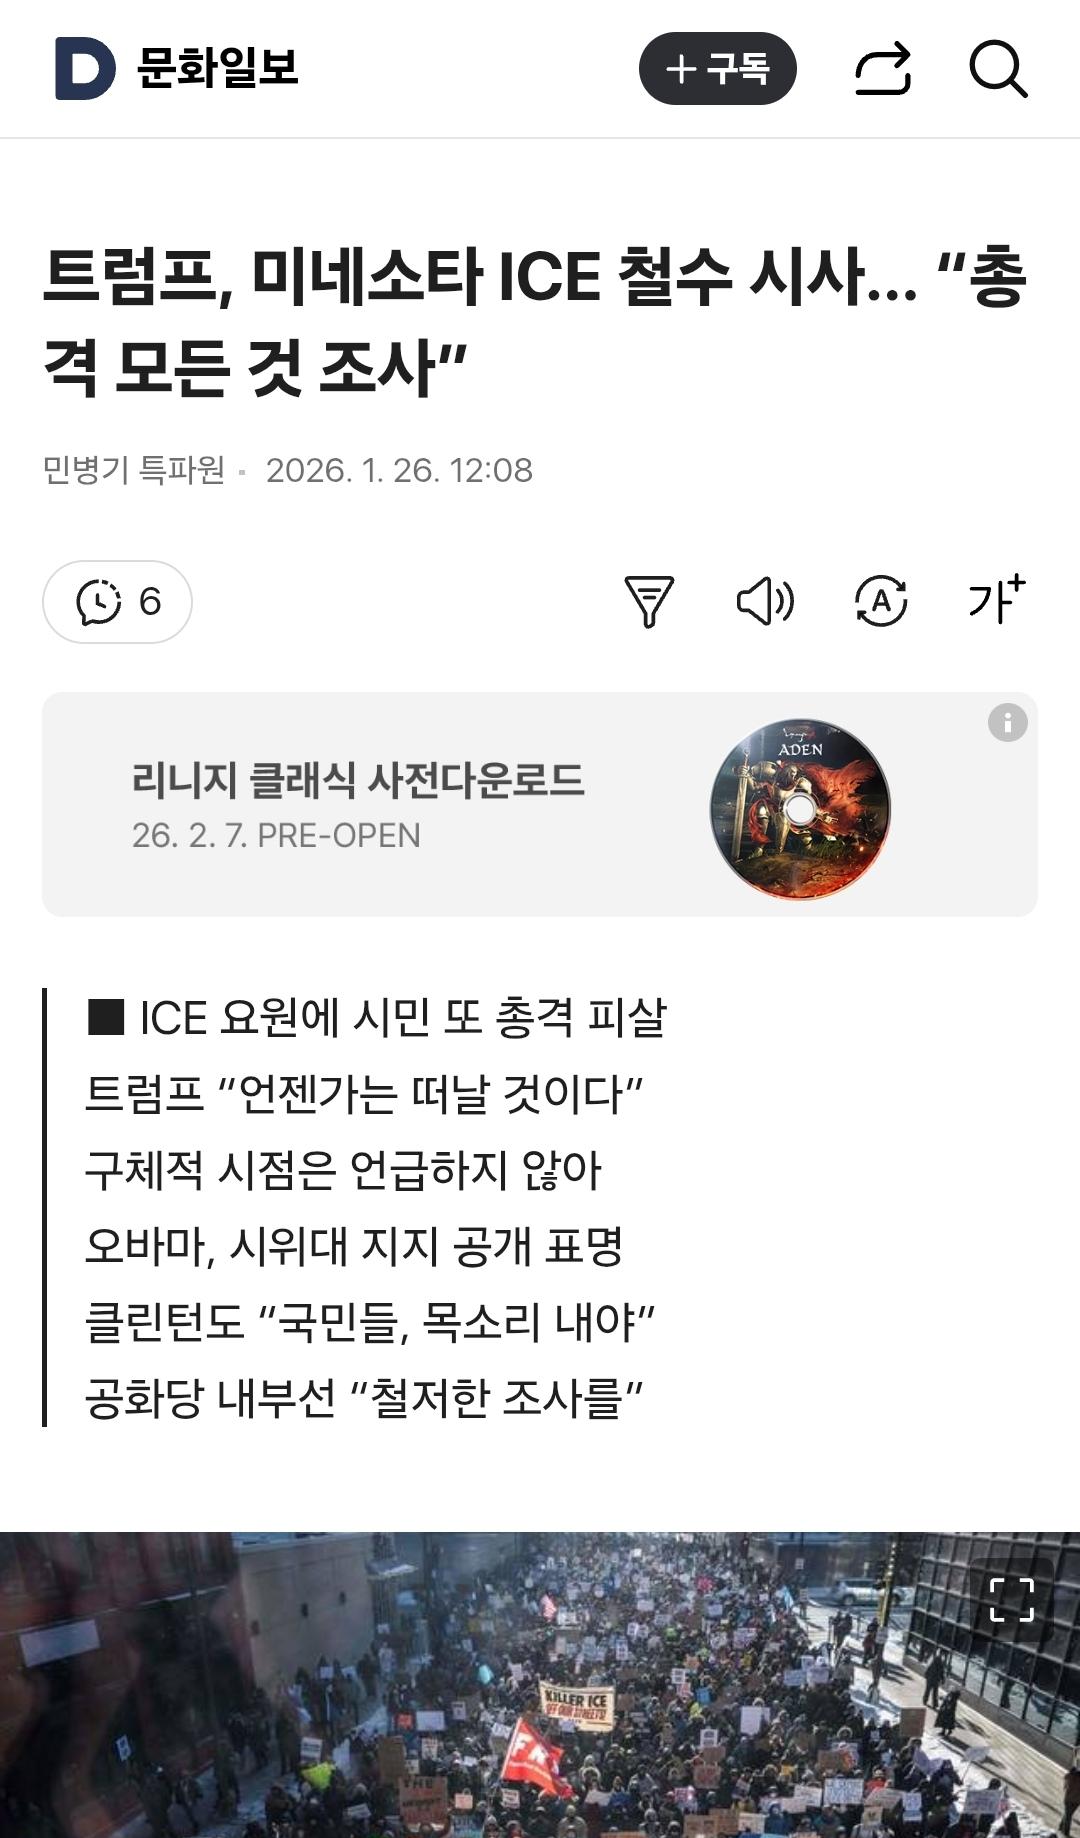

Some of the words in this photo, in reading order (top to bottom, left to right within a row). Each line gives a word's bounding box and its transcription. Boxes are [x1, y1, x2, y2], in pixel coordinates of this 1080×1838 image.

[137, 47, 298, 88] 문화일보
[707, 53, 770, 85] 구독
[43, 246, 232, 309] 트럼프,
[254, 246, 484, 306] 미네소타
[501, 251, 600, 301] ICE
[618, 246, 733, 306] 철수
[938, 244, 1026, 308] “총
[44, 338, 95, 398] 격
[116, 340, 230, 398] 모든
[248, 338, 302, 398] 것
[320, 338, 467, 398] 조사”
[45, 456, 127, 485] 민병기
[139, 456, 223, 486] 특파원
[267, 458, 351, 482] 2026.
[363, 458, 382, 482] 1.
[394, 458, 439, 482] 26.
[451, 458, 532, 482] 12:08
[140, 587, 161, 615] 6
[778, 744, 823, 756] ADEN
[134, 761, 235, 800] 리니지
[250, 761, 354, 800] 클래식
[368, 761, 585, 800] 사전다운로드
[133, 822, 177, 848] 26.
[190, 822, 215, 847] 2.
[226, 823, 246, 847] 7.
[259, 822, 419, 848] PRE-OPEN
[143, 1000, 206, 1035] ICE
[221, 997, 337, 1038] 요원에
[354, 997, 428, 1038] 시민
[444, 1000, 482, 1033] 또
[496, 996, 571, 1039] 총격
[589, 997, 667, 1038] 피살
[85, 1074, 204, 1114] 트럼프
[219, 1074, 398, 1115] “언젠가는
[413, 1074, 491, 1115] 떠날
[504, 1074, 643, 1115] 것이다”
[85, 1150, 201, 1191] 구체적
[218, 1150, 336, 1191] 시점은
[352, 1150, 505, 1191] 언급하지
[523, 1150, 602, 1191] 않아
[85, 1226, 214, 1269] 오바마,
[230, 1226, 346, 1267] 시위대
[362, 1226, 436, 1267] 지지
[454, 1226, 530, 1268] 공개
[545, 1226, 621, 1267] 표명
[86, 1302, 244, 1344] 클린턴도
[259, 1302, 408, 1345] “국민들,
[423, 1302, 538, 1344] 목소리
[557, 1302, 655, 1343] 내야”
[85, 1378, 205, 1420] 공화당
[219, 1378, 334, 1419] 내부선
[351, 1378, 491, 1419] “철저한
[503, 1378, 643, 1420] 조사를”
[545, 1690, 584, 1706] KILLER
[588, 1695, 607, 1708] ICE
